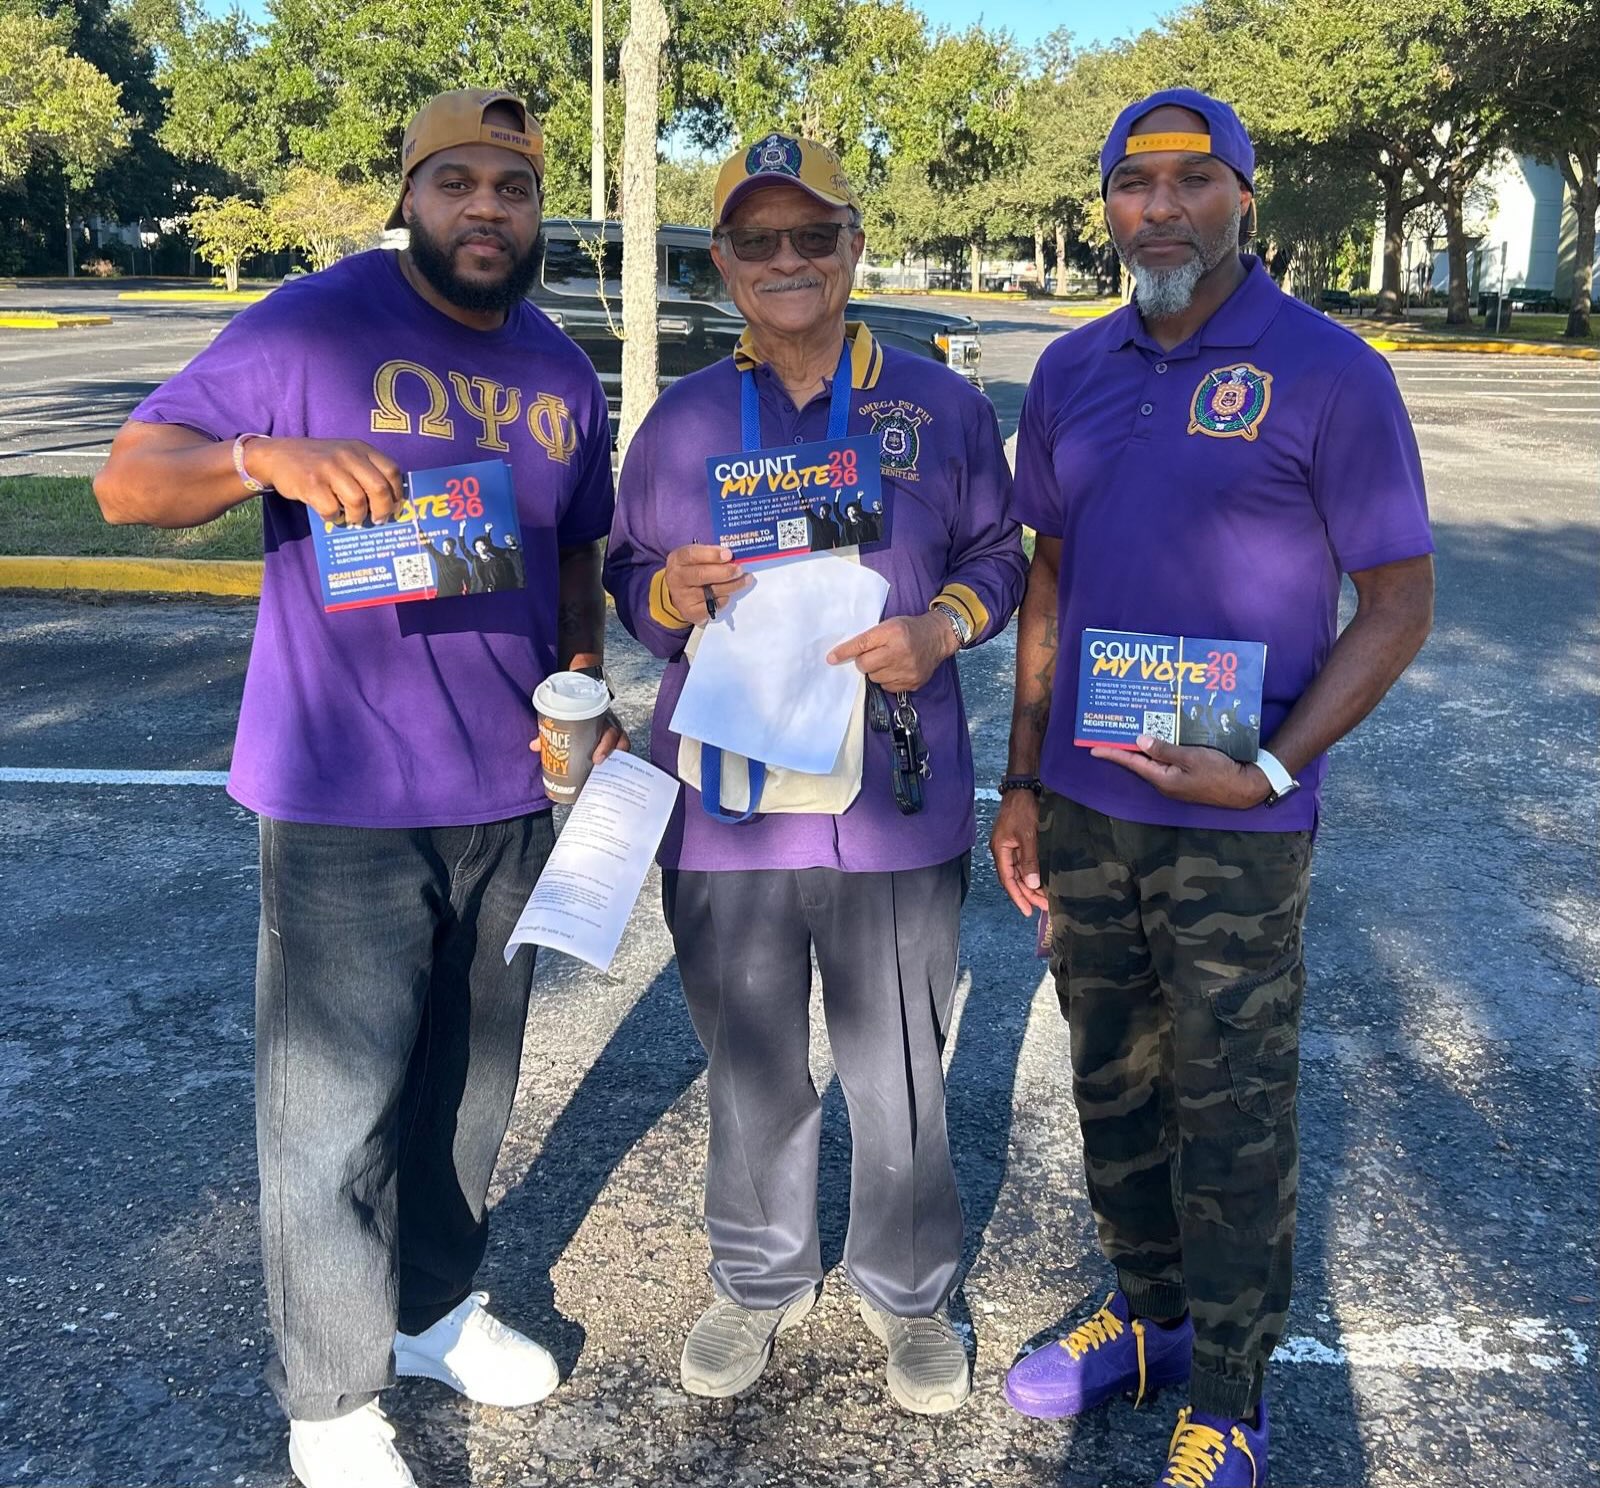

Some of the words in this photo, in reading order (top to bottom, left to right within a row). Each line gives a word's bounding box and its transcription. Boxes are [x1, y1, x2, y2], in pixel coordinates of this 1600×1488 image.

[491, 131, 510, 141] OMEGA
[858, 400, 895, 416] OMEGA
[898, 400, 914, 412] PSI
[916, 407, 932, 424] PHI
[714, 455, 797, 482] COUNT
[828, 450, 857, 470] 20
[720, 476, 762, 499] MY
[768, 464, 830, 492] VOTE
[829, 468, 858, 488] 26
[446, 477, 480, 500] 20
[394, 494, 451, 523] OTE
[449, 497, 484, 521] 26
[720, 532, 740, 540] SCAN
[740, 530, 760, 538] HERE
[720, 538, 755, 548] REGISTER
[755, 535, 774, 544] NOW!
[328, 570, 352, 582] SCAN
[352, 568, 374, 578] HERE
[375, 566, 386, 574] TO
[329, 577, 369, 589] REGISTER
[369, 573, 392, 584] NOW!
[1089, 640, 1174, 662] COUNT
[1092, 656, 1135, 678] MY
[1141, 661, 1208, 683] VOTE
[1207, 651, 1238, 672] 20
[1204, 672, 1236, 691] 26
[1083, 719, 1118, 728] REGISTER
[1119, 721, 1140, 730] NOW!
[1084, 712, 1104, 720] SCAN
[1104, 714, 1124, 722] HERE
